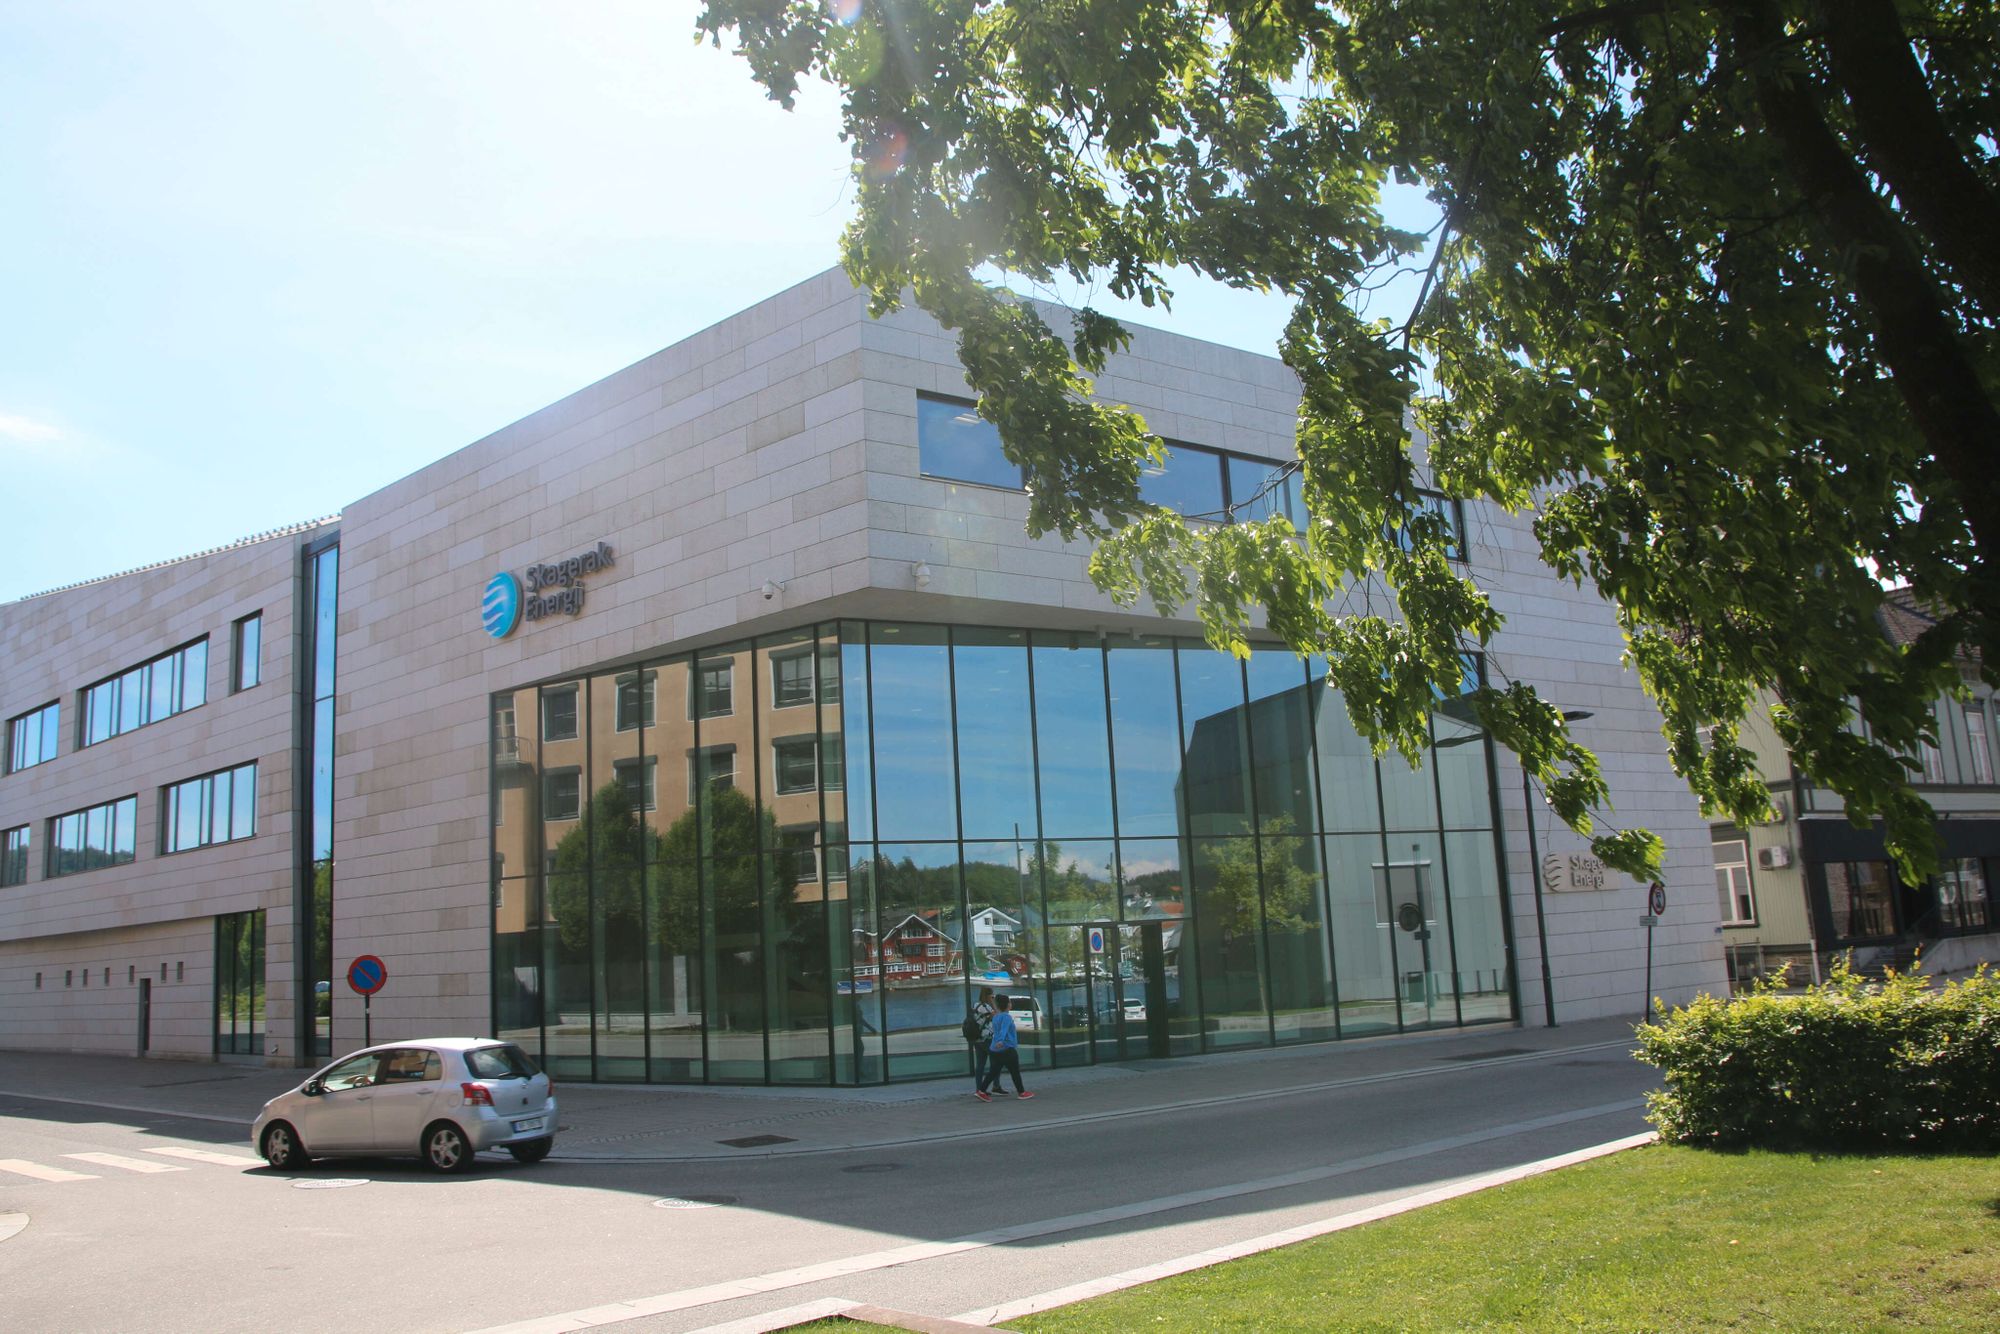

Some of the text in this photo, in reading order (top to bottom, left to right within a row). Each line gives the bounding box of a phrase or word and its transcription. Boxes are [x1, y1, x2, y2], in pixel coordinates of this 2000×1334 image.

[526, 541, 615, 592] Skagerak
[526, 580, 585, 622] Energi
[1569, 854, 1608, 873] Skage
